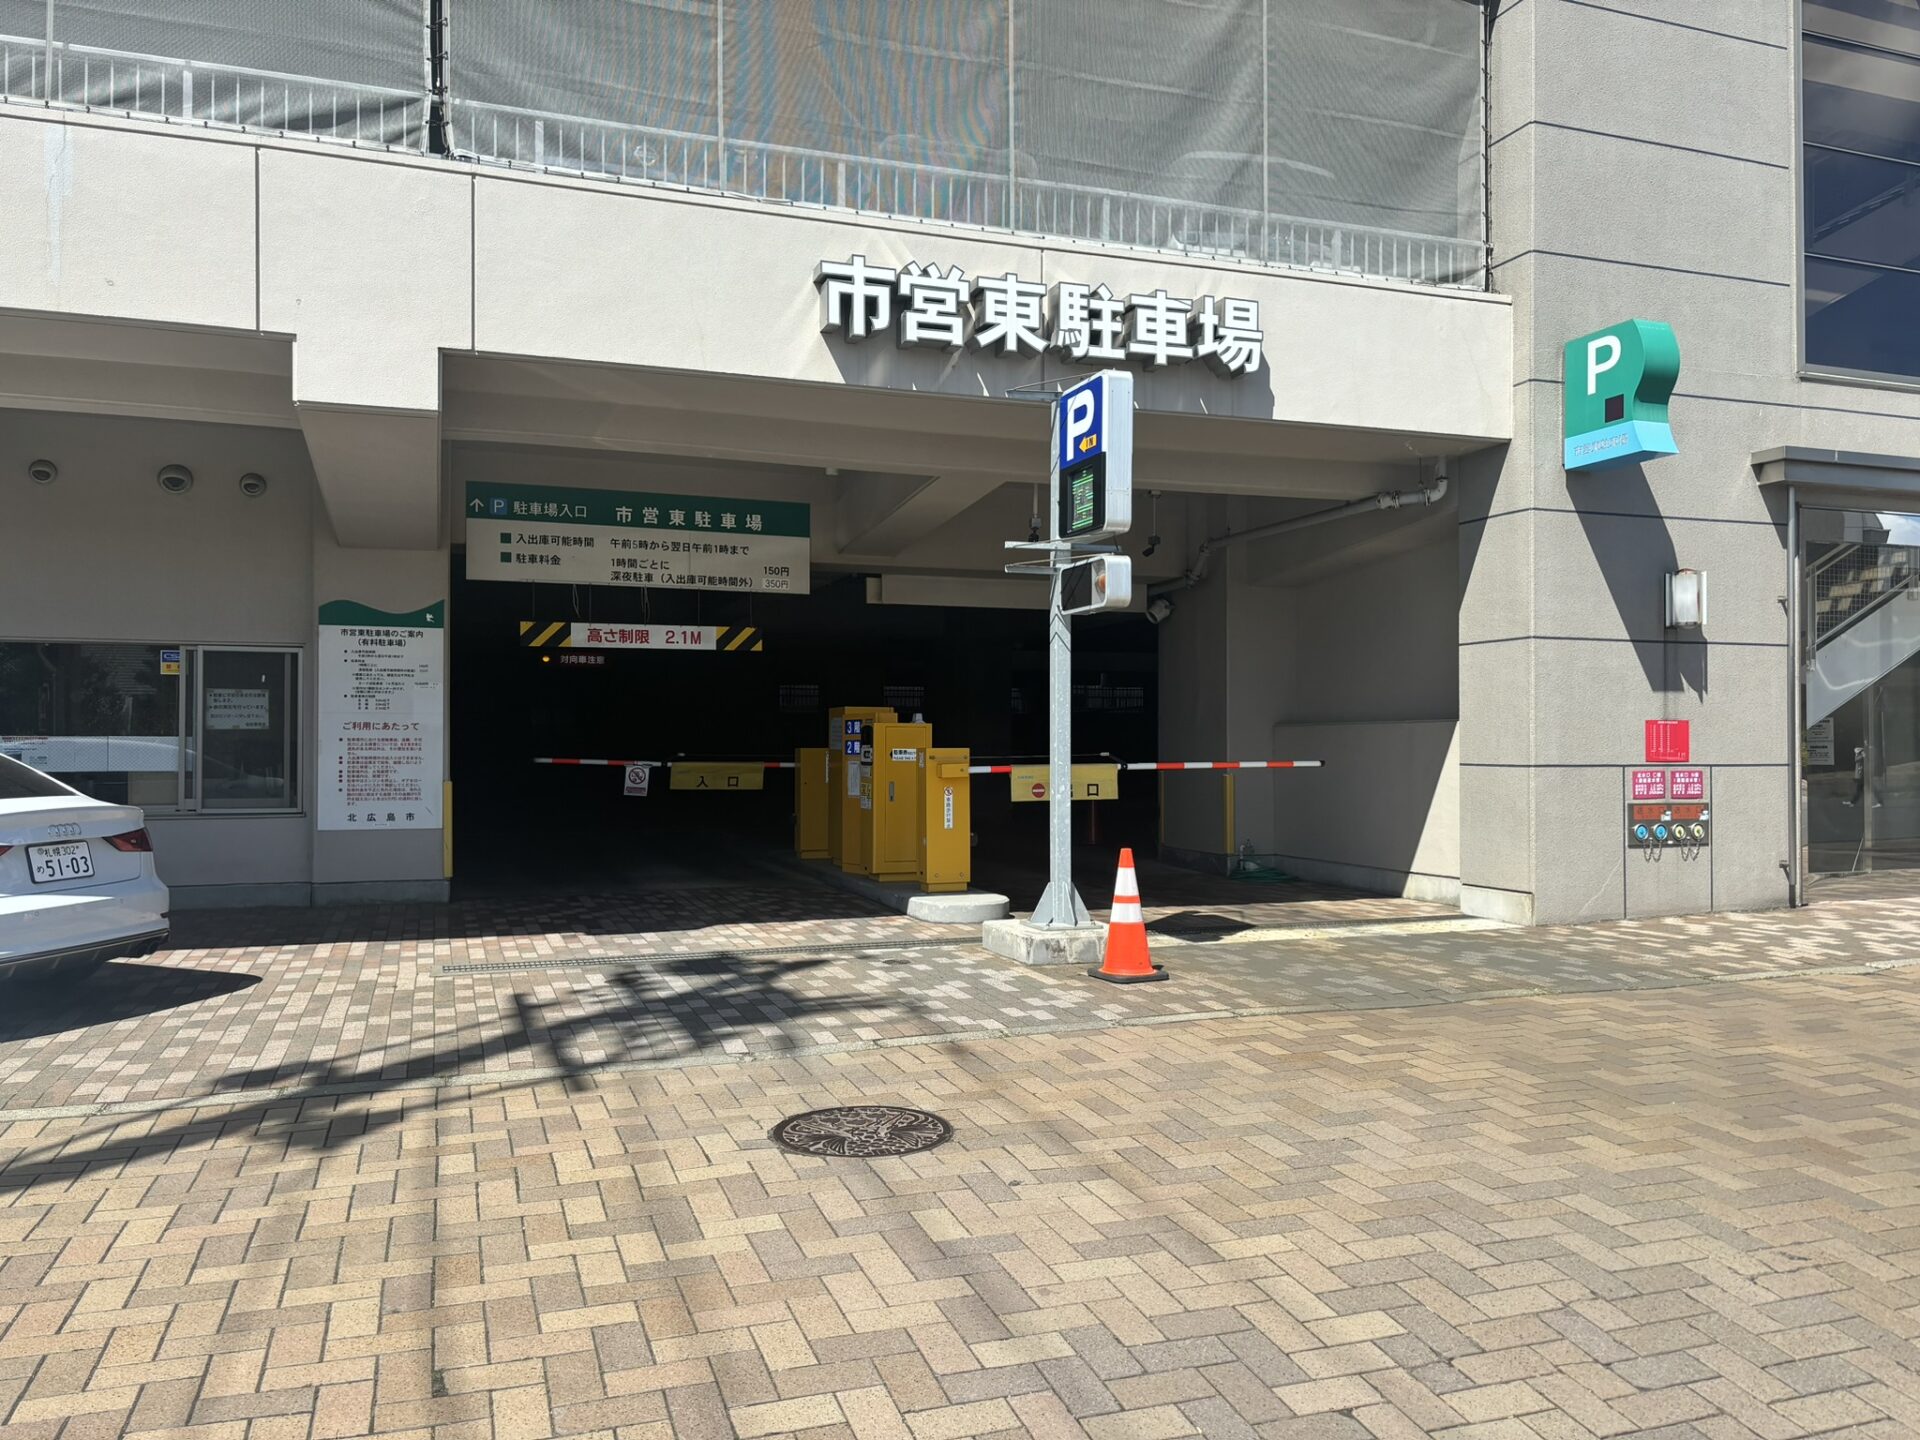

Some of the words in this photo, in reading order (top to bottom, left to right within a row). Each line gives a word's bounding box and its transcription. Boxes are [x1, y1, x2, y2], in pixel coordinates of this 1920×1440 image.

[815, 254, 1264, 375] 市営東駐車場
[1587, 335, 1622, 396] P
[1066, 388, 1095, 462] P
[493, 499, 505, 514] P
[513, 500, 588, 519] 駐車場入口
[615, 506, 763, 532] 市営東駐車場
[516, 533, 594, 549] 入出庫可能時間
[610, 538, 750, 556] 午前5時から翌日午前1時まで
[516, 553, 561, 566] 駐車料金
[610, 558, 670, 571] 1時間ごとに
[763, 566, 790, 577] 150円
[764, 578, 789, 589] 350円
[340, 628, 424, 638] 市営東駐車場のご案内
[587, 628, 650, 645] 高さ制限
[665, 630, 702, 645] 2.1M
[342, 721, 420, 731] ご利用にあたって
[696, 775, 740, 788] 入口
[347, 813, 415, 822] 北広島市
[37, 865, 45, 874] め
[45, 856, 90, 877] 51-03
